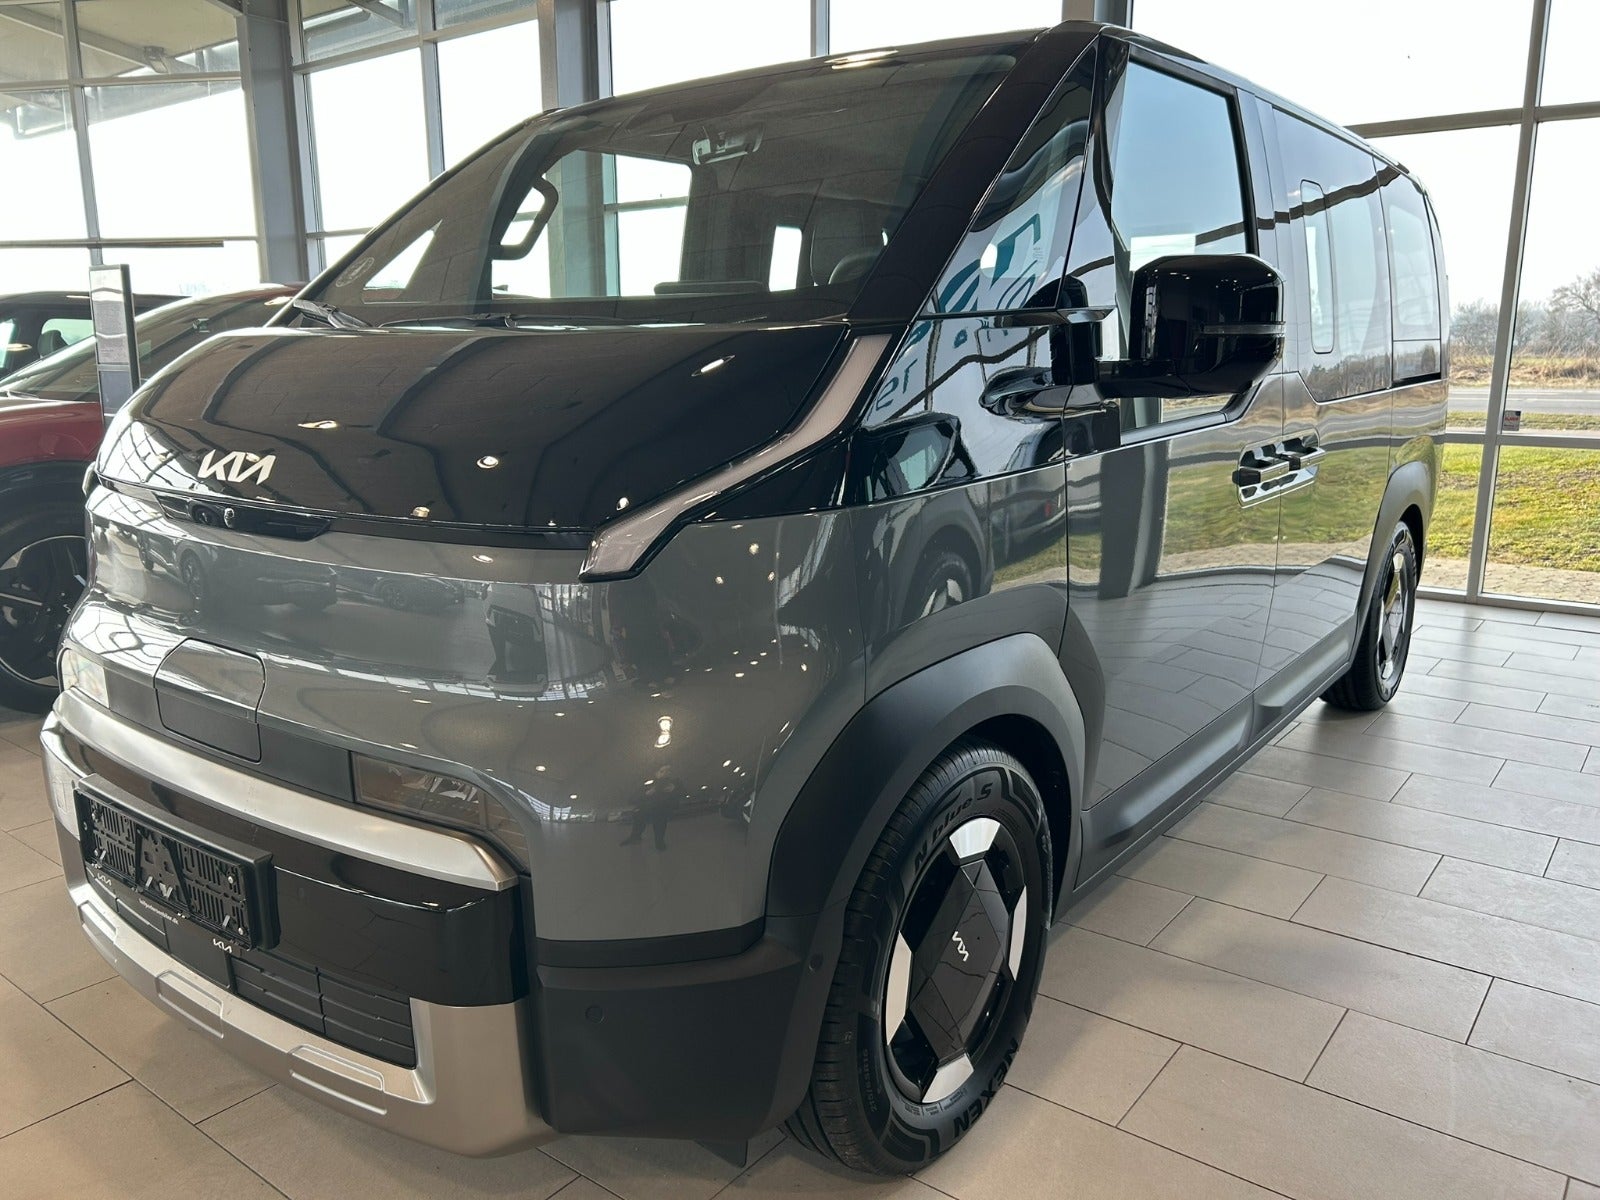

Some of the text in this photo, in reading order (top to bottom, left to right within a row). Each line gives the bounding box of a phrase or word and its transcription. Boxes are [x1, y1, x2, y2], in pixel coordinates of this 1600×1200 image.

[197, 448, 276, 486] KIA
[932, 797, 973, 845] blue
[212, 938, 232, 954] KIA
[952, 931, 969, 961] KIA
[953, 1037, 1019, 1138] NEXEN
